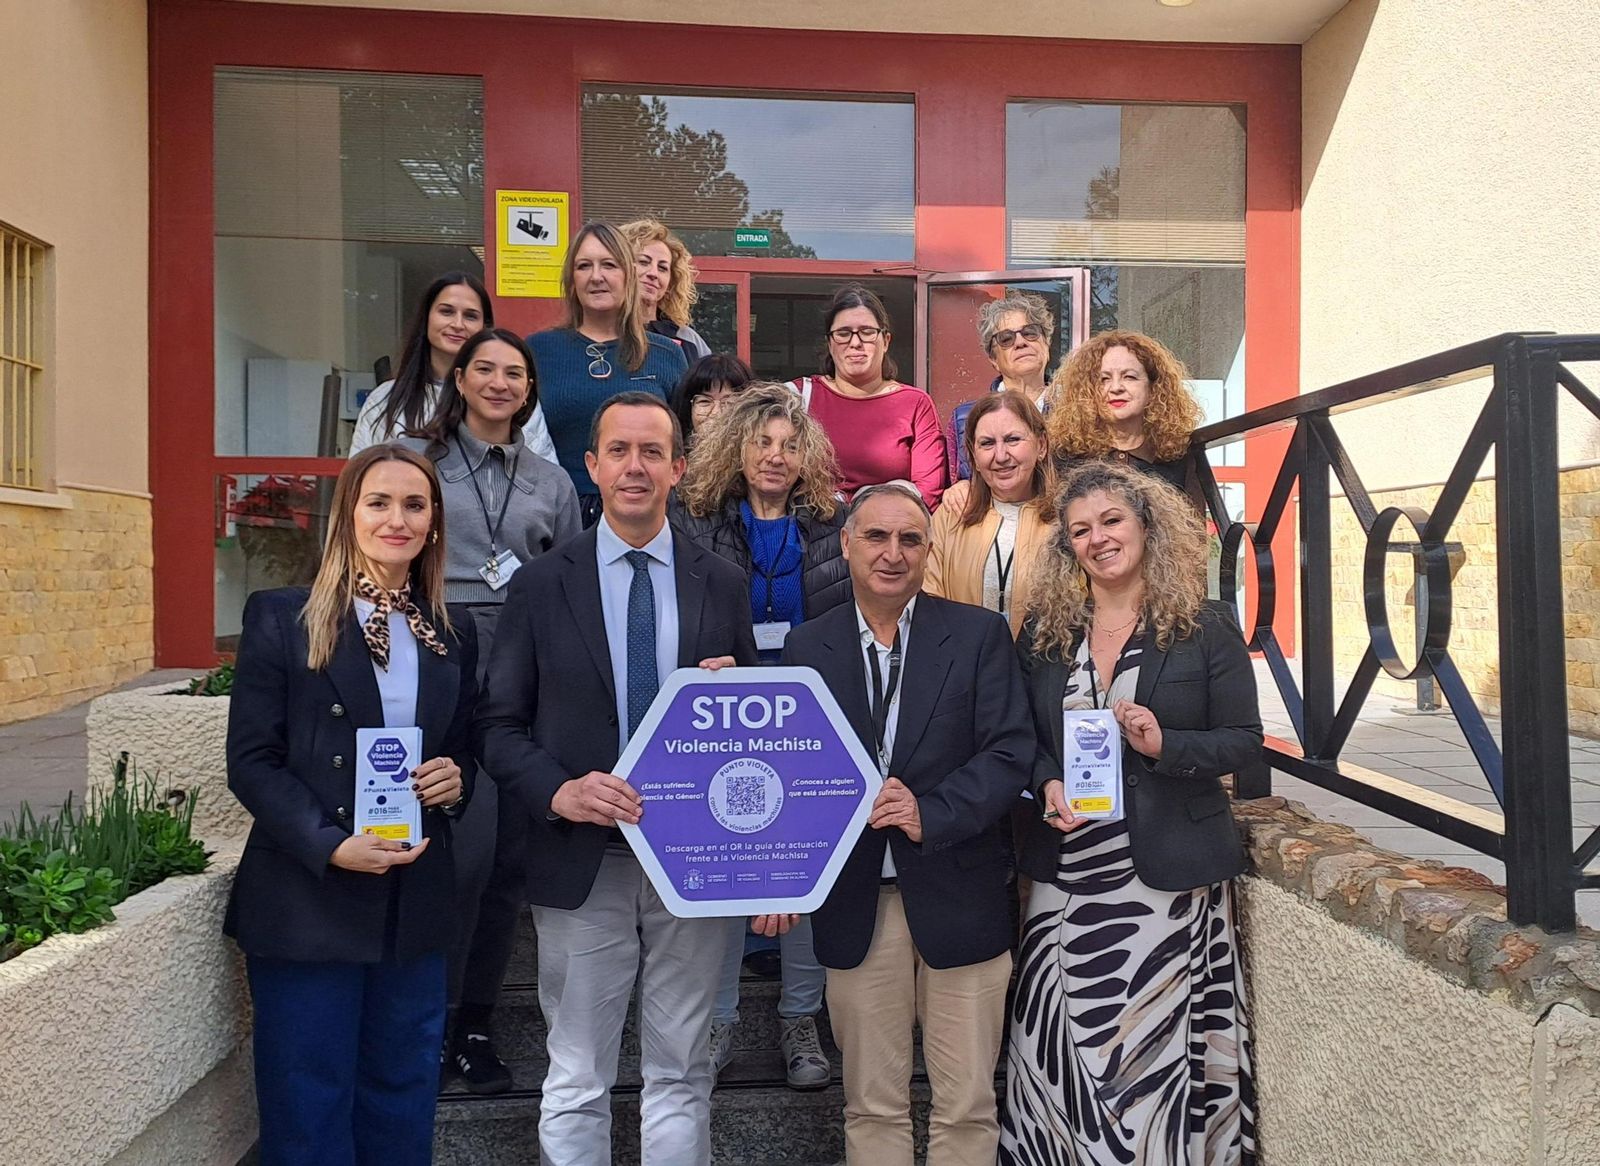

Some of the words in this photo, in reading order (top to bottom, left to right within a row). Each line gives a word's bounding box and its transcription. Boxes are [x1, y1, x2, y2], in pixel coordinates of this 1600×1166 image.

[736, 234, 768, 242] ENTRADA
[692, 695, 797, 730] STOP
[376, 744, 400, 752] STOP
[664, 738, 743, 754] Violencia
[749, 737, 822, 752] Machista
[720, 761, 744, 777] PUNTO
[746, 761, 774, 780] VIOLETA
[641, 782, 662, 790] ¿Estás
[792, 778, 824, 786] ¿Conoces
[830, 778, 854, 786] alguien
[818, 788, 858, 796] sufriéndola?
[368, 806, 388, 814] #016
[710, 796, 720, 818] contra
[720, 816, 728, 826] las
[729, 824, 762, 832] violencias
[665, 845, 704, 854] Descarga
[720, 843, 728, 851] el
[730, 843, 742, 851] QR
[754, 842, 772, 852] guía
[788, 841, 828, 849] actuación
[730, 853, 770, 861] Violencia
